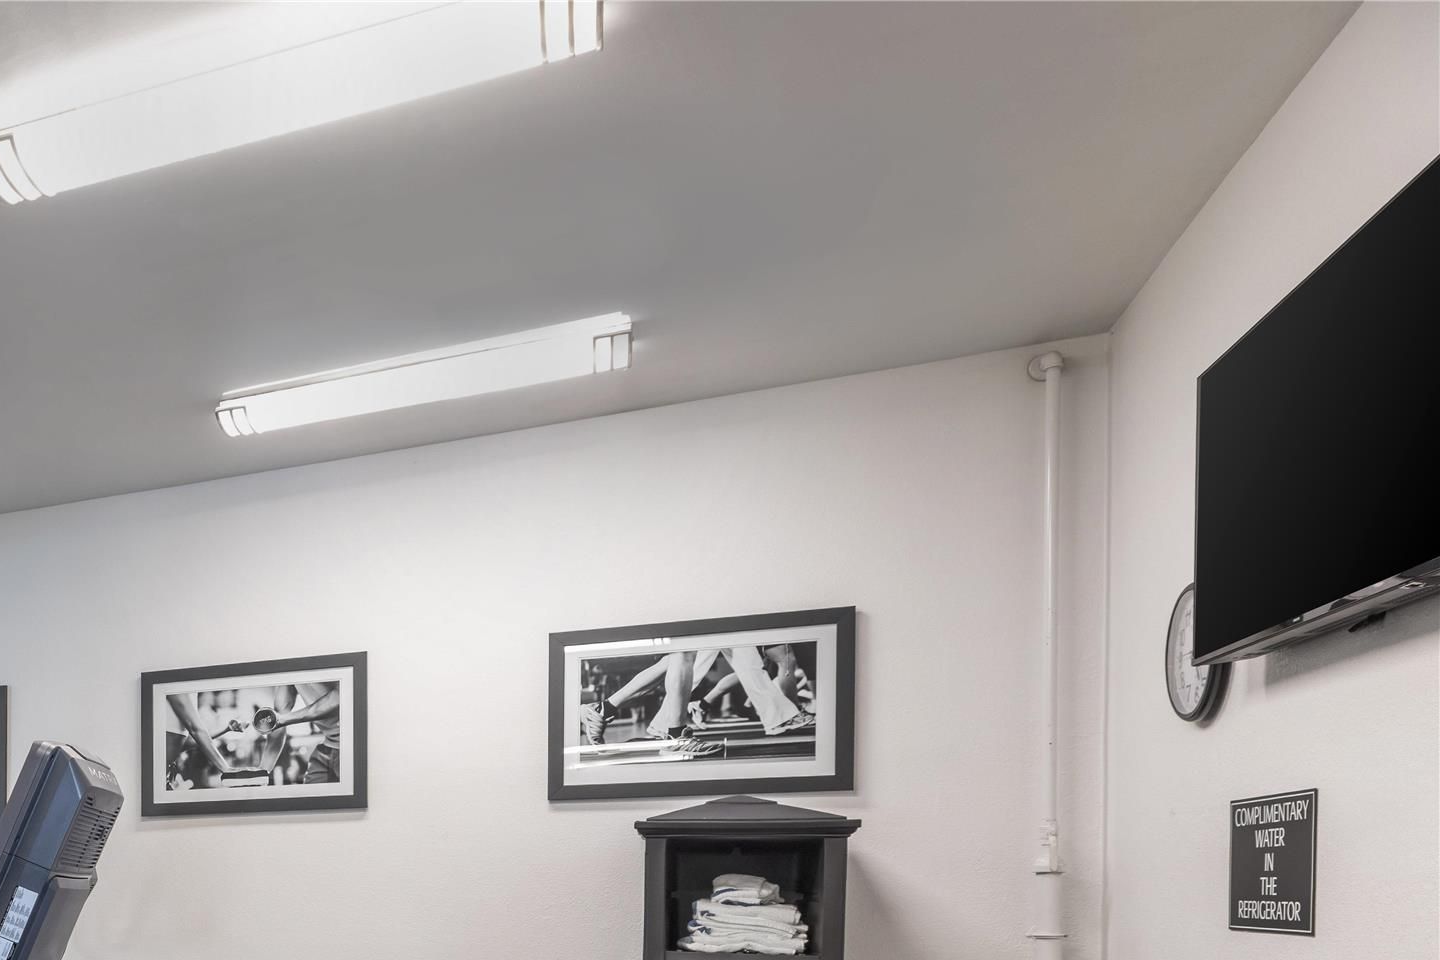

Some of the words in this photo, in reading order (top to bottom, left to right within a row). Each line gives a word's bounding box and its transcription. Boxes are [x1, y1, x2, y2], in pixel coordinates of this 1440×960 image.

[1234, 799, 1310, 827] COMPLIMENTARY
[1255, 827, 1285, 848] WATER
[1264, 852, 1275, 871] IN
[1260, 876, 1277, 895] THE
[1238, 900, 1301, 921] REFRIGERATOR
